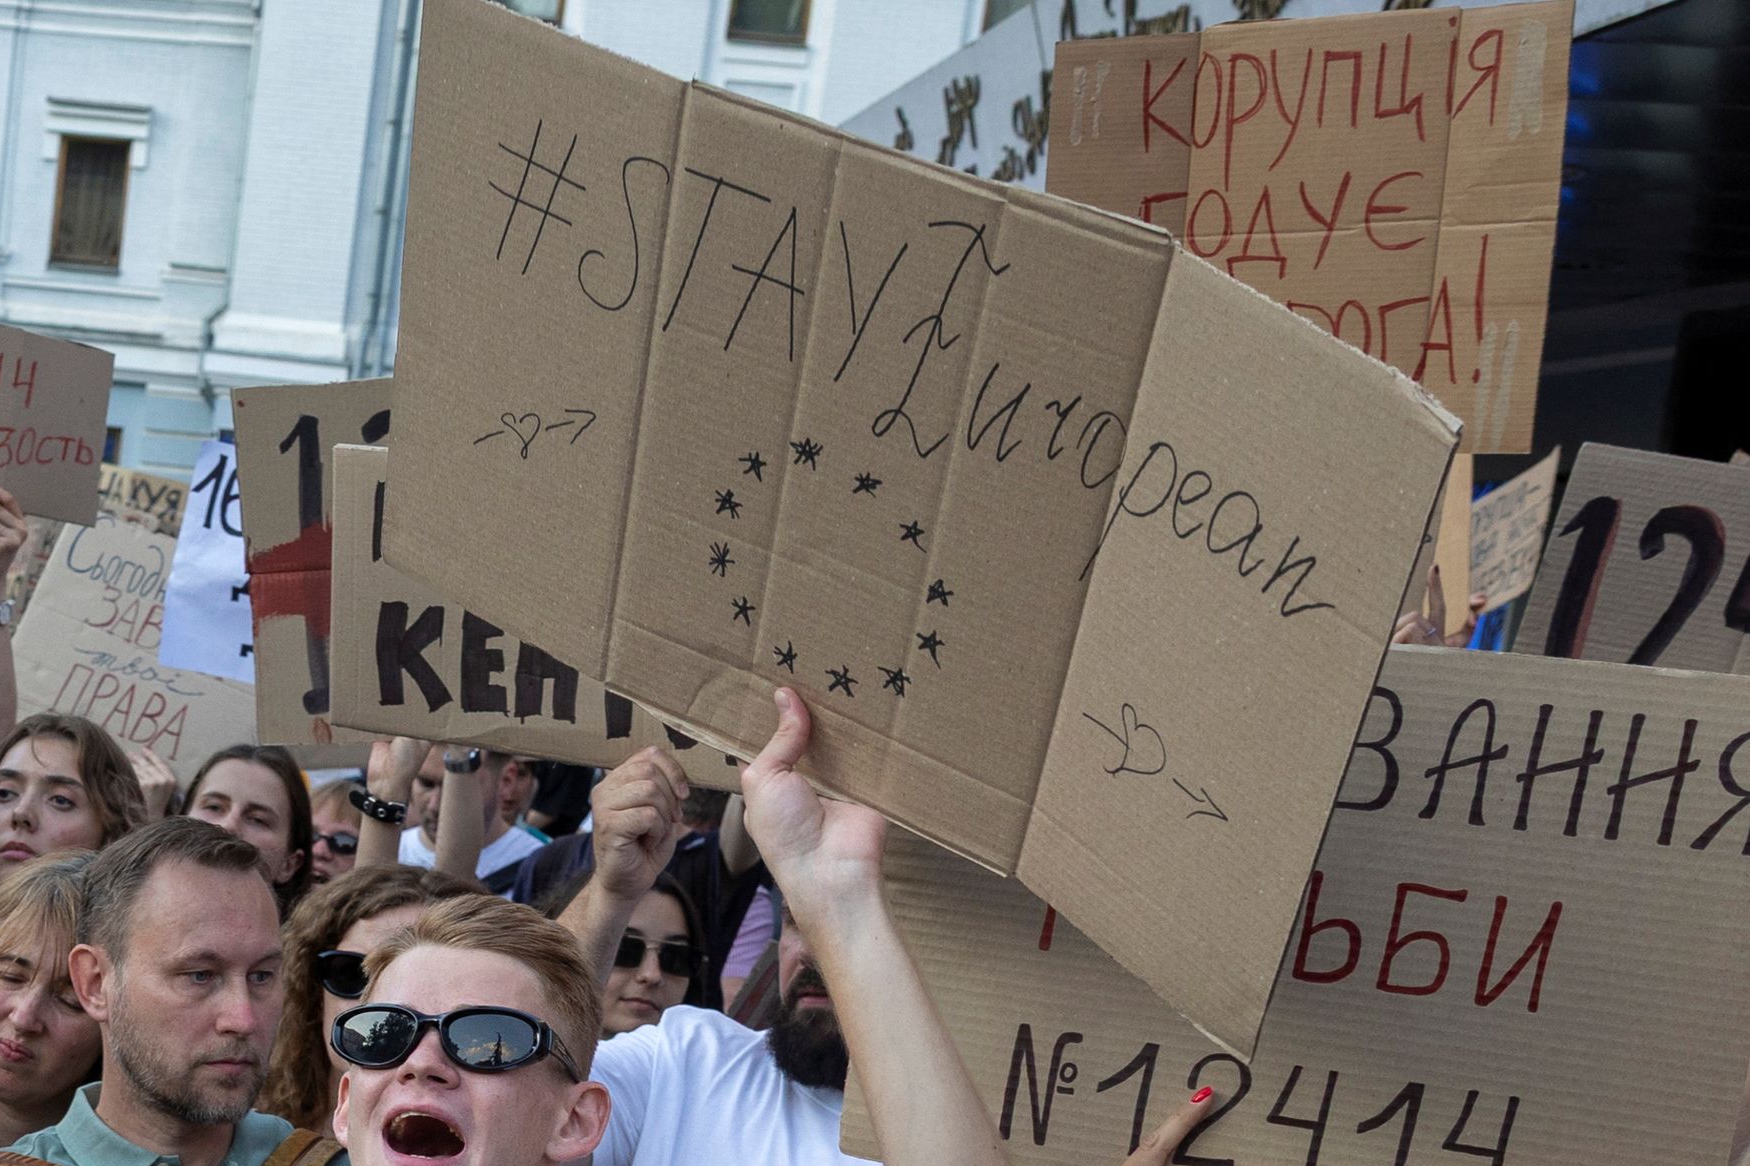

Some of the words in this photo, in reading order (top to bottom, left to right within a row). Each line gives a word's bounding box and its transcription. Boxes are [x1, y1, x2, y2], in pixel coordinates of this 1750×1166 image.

[1141, 17, 1504, 191] КОРУПЦІЯ
[488, 118, 907, 381] #STAY
[1557, 495, 1750, 667] 12
[48, 662, 189, 761] ПРАВА
[1336, 685, 1750, 855] ВАННЯ
